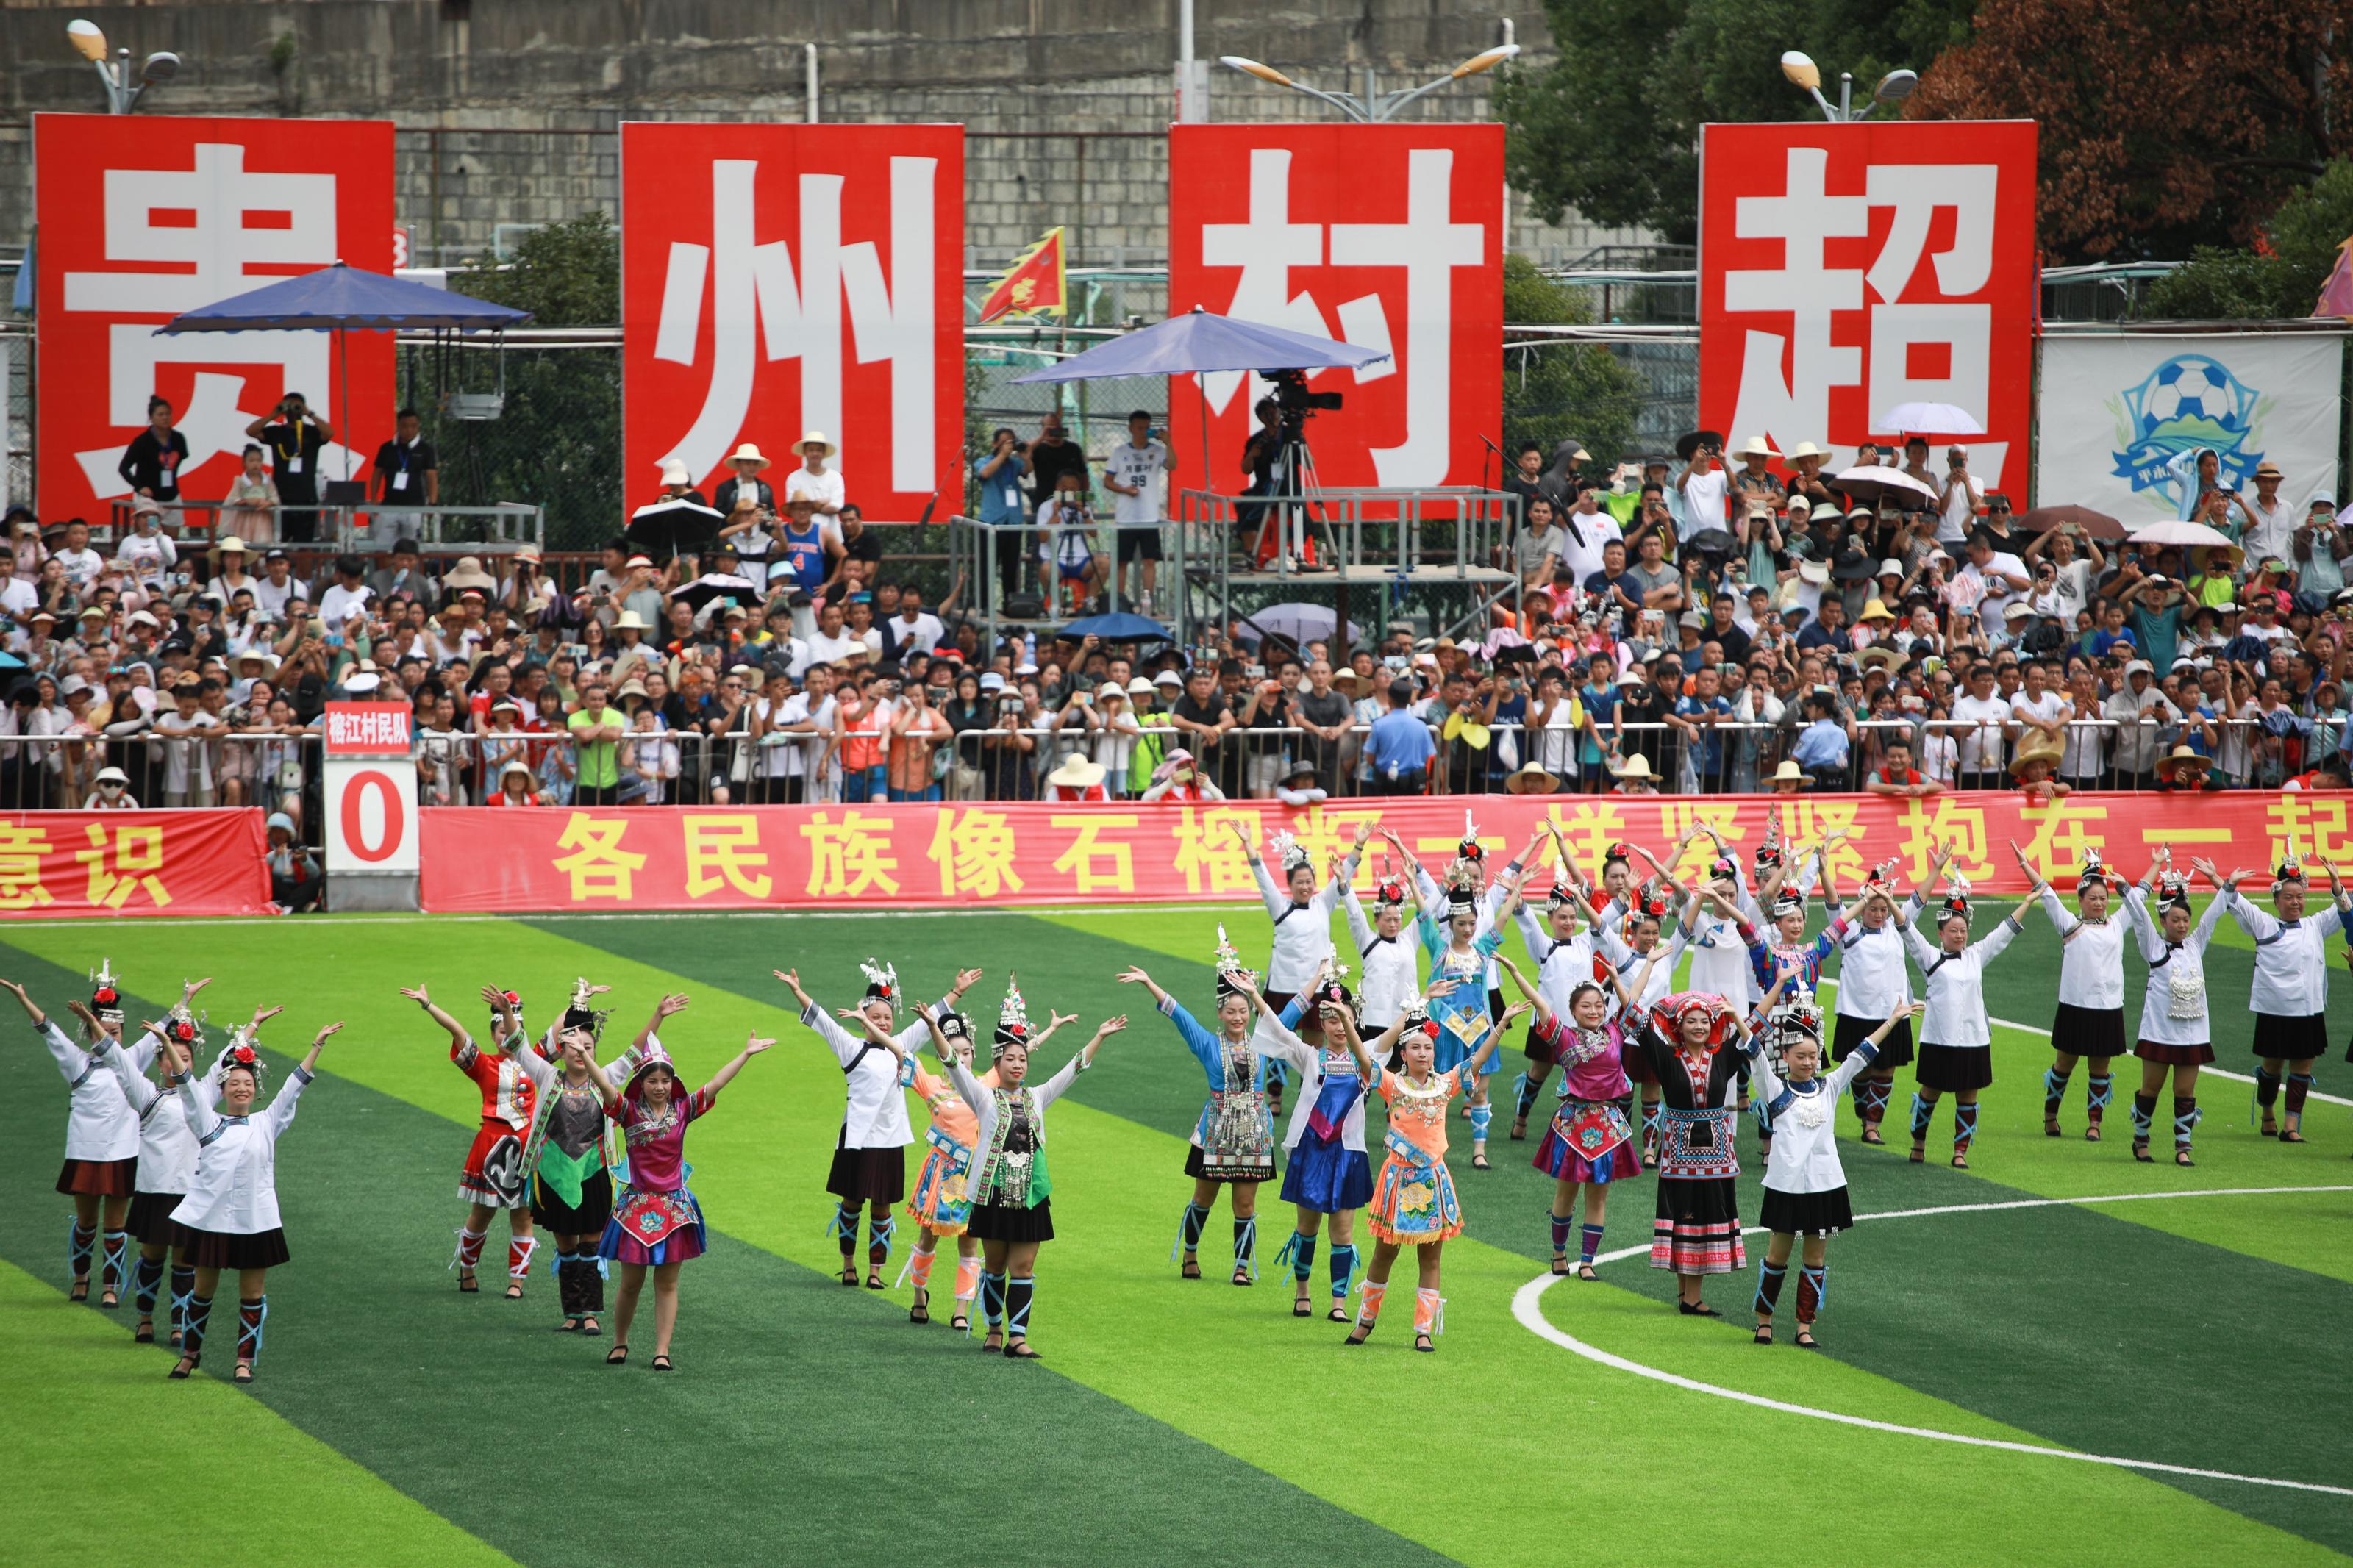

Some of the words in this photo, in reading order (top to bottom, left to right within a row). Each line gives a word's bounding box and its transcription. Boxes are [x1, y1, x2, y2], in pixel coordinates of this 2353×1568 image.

[792, 553, 804, 570] 4
[329, 711, 410, 745] 榕江村民队
[340, 769, 404, 862] 0
